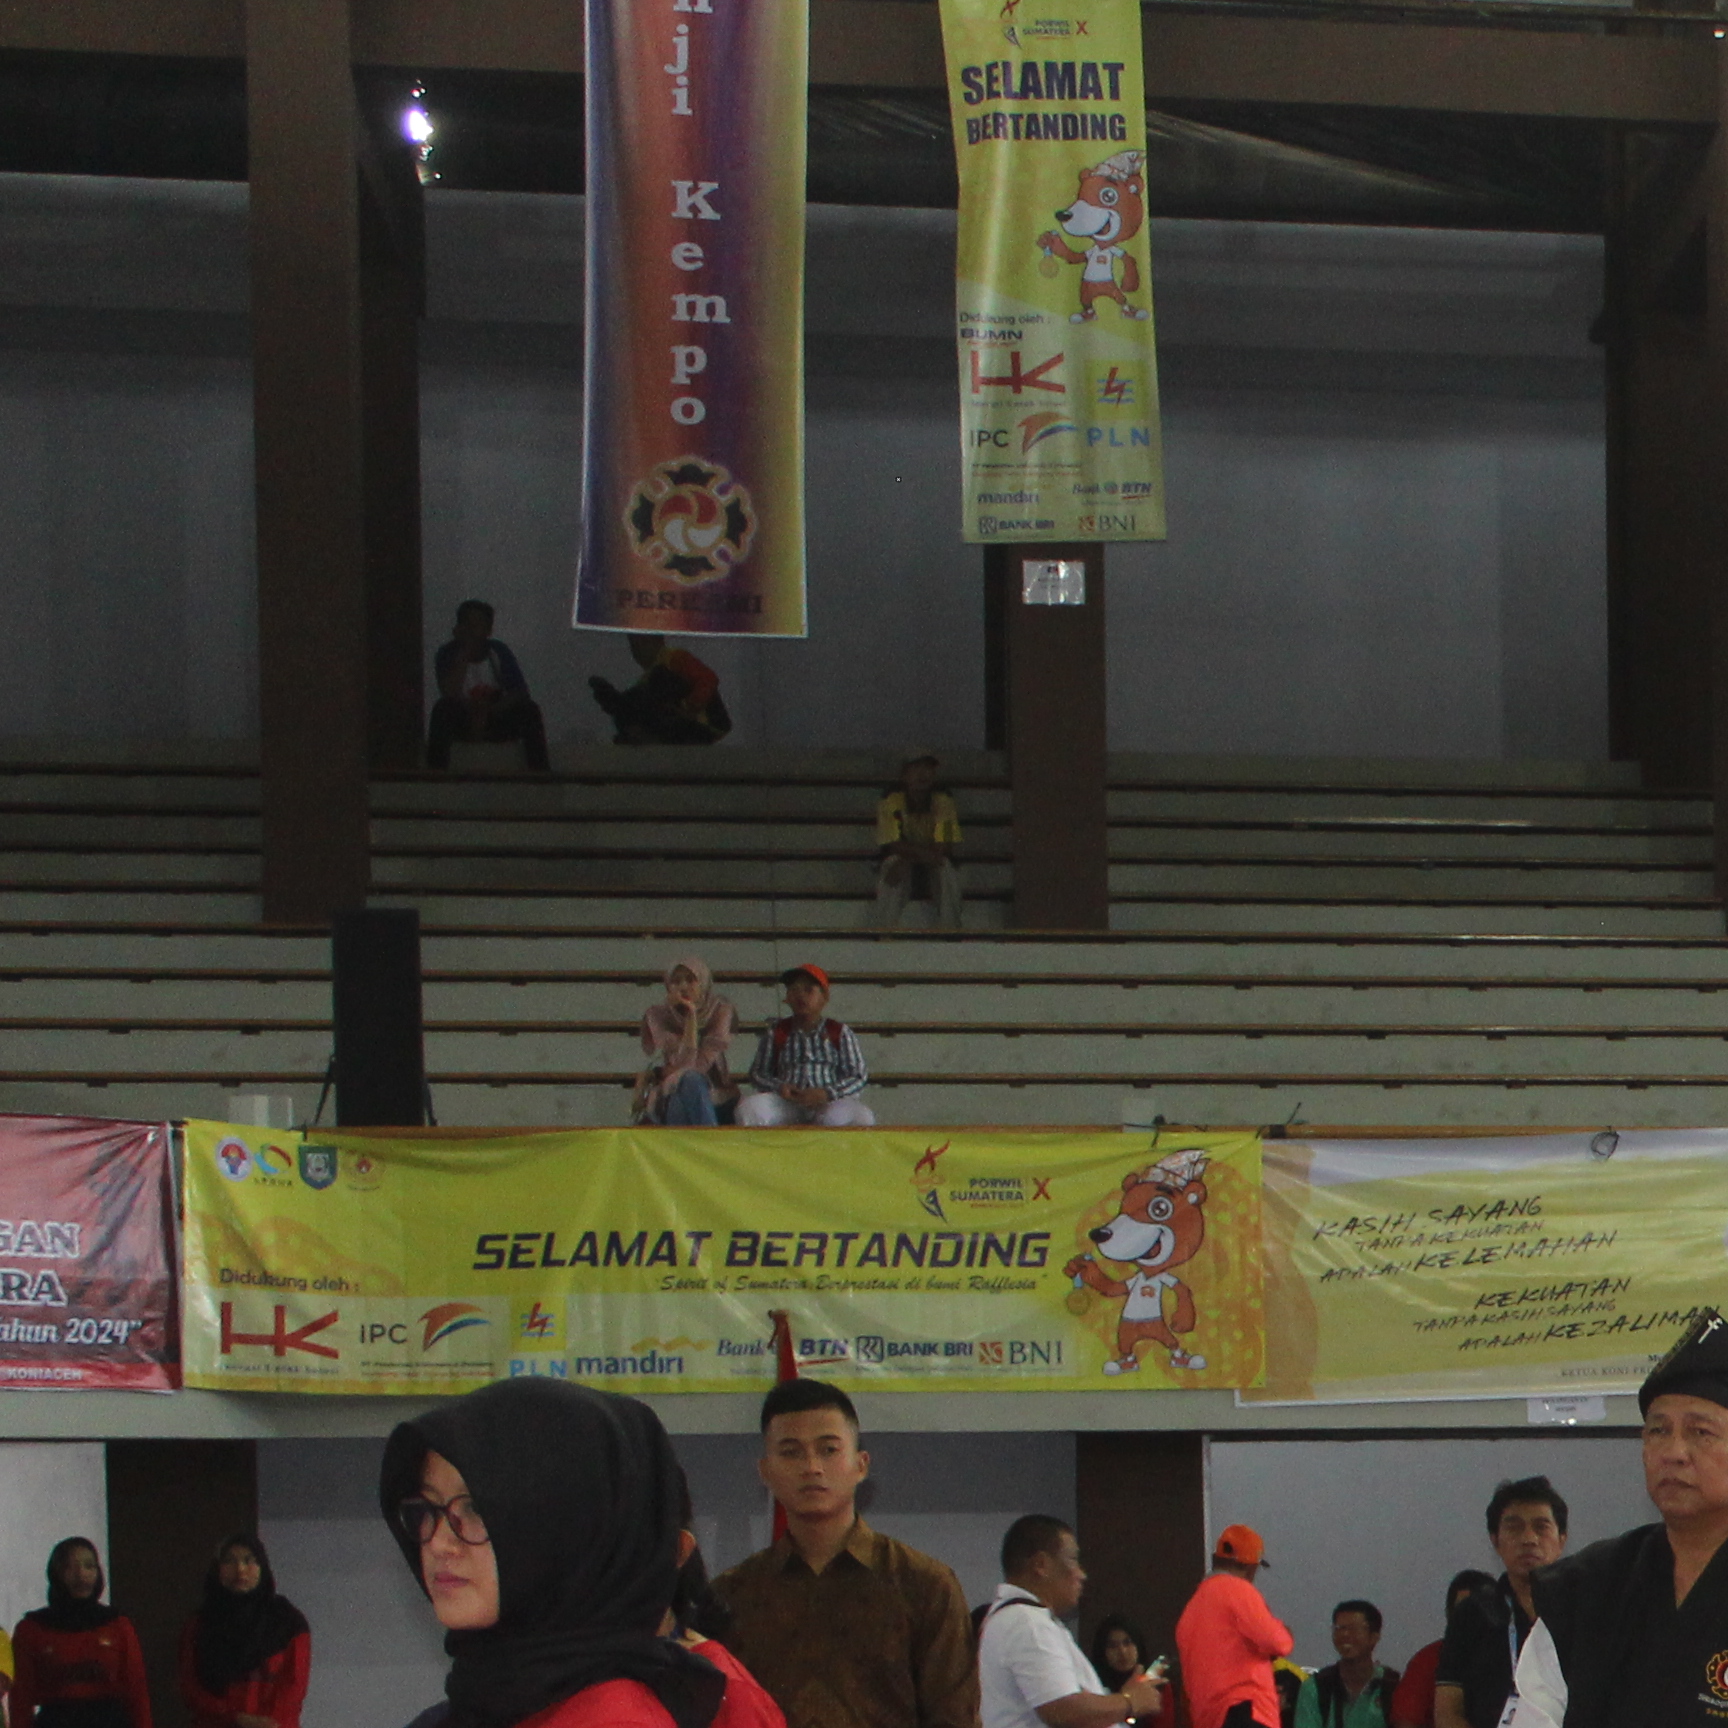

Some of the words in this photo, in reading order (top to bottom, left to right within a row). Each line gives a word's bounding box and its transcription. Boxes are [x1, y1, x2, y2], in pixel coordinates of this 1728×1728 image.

[961, 60, 1125, 106] SELAMAT
[966, 112, 1127, 146] BERTANDING
[669, 179, 732, 426] Kempo
[970, 429, 1009, 448] IPC
[1086, 427, 1150, 447] PLN
[1099, 515, 1136, 532] BNI
[950, 1189, 1025, 1202] SUMATERA
[1031, 1177, 1052, 1202] X
[969, 1177, 1023, 1189] PORWIL
[1428, 1195, 1542, 1224] SAYANG
[472, 1230, 712, 1270] SELAMAT
[725, 1230, 1052, 1269] BERTANDING
[219, 1268, 307, 1292] Didukung
[312, 1276, 350, 1292] oleh
[1474, 1276, 1632, 1311] KEKUATAN
[0, 1316, 61, 1344] ahun
[220, 1301, 339, 1360] HK
[359, 1323, 408, 1345] IPC
[717, 1338, 766, 1357] Bank
[800, 1338, 849, 1356] BTN
[887, 1341, 939, 1357] BANK
[943, 1341, 973, 1357] BRI
[1009, 1341, 1063, 1366] BNI
[509, 1358, 568, 1378] PLN
[576, 1350, 684, 1375] mandiri
